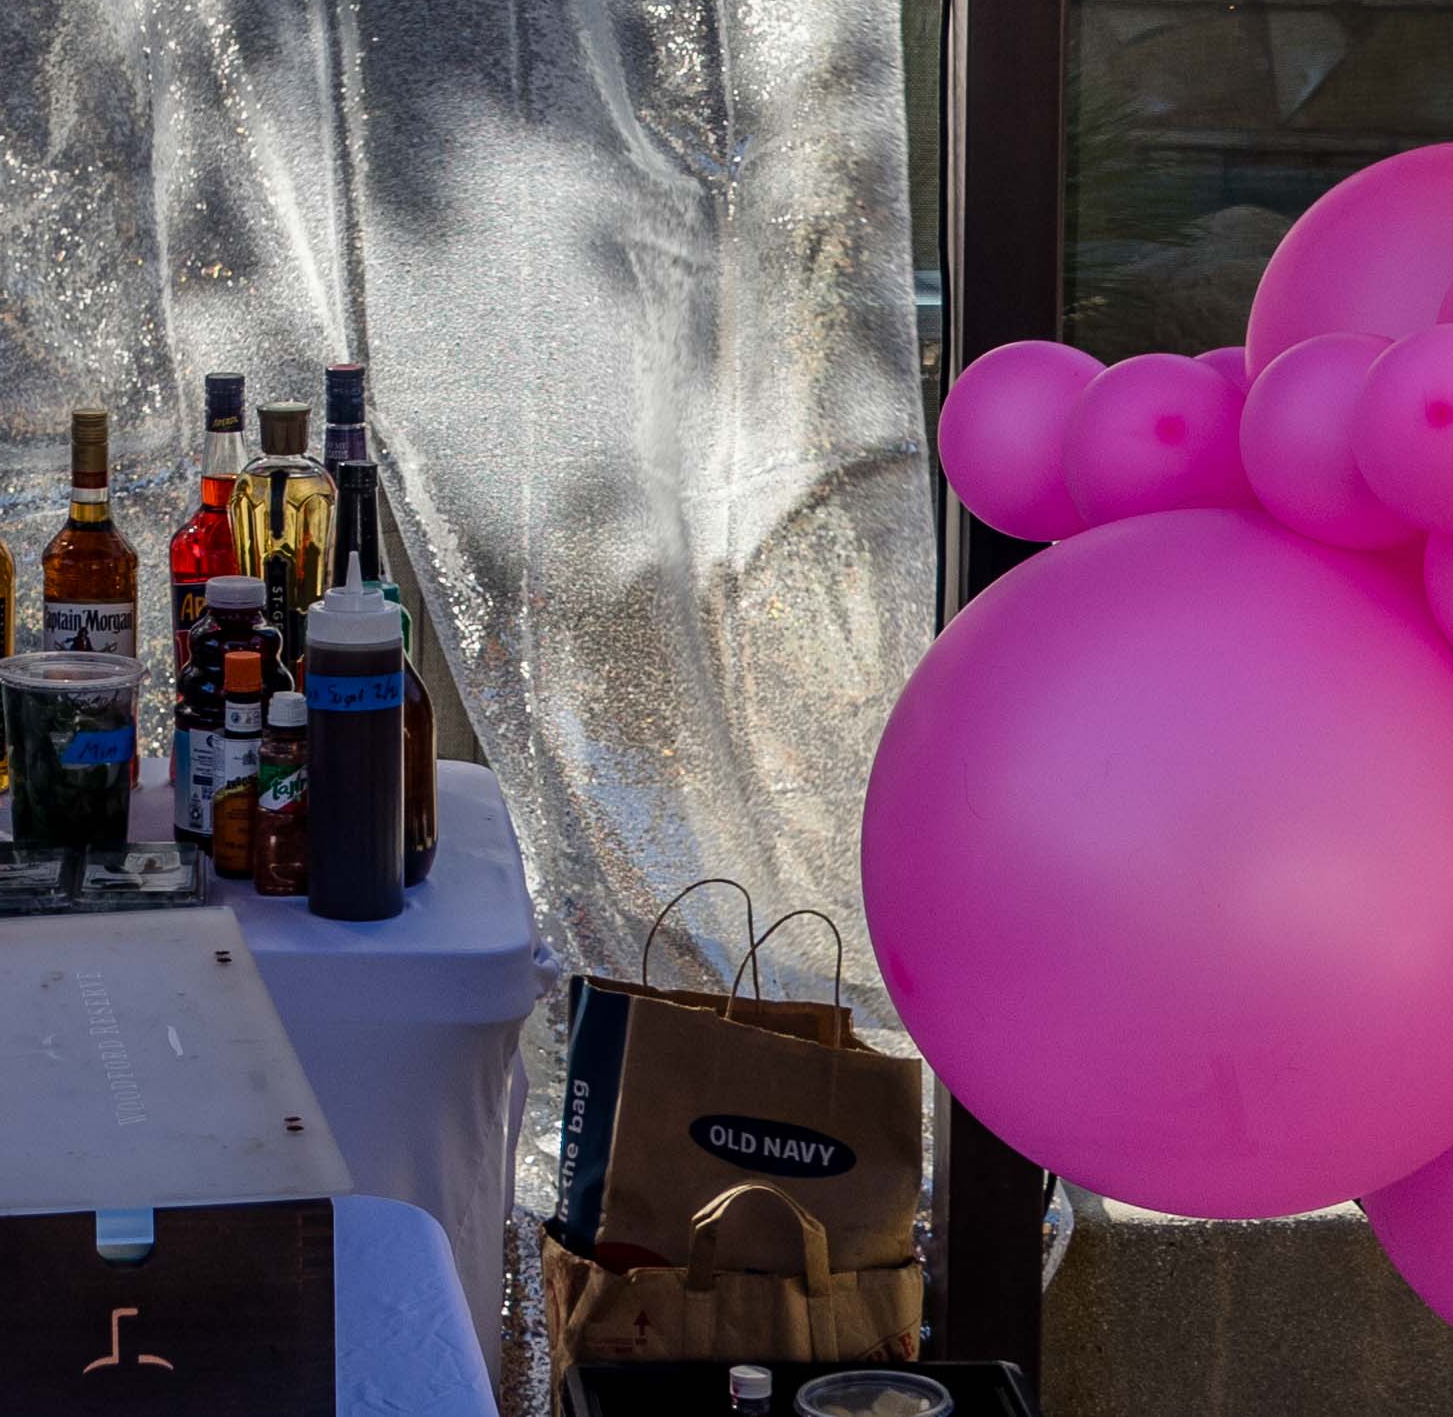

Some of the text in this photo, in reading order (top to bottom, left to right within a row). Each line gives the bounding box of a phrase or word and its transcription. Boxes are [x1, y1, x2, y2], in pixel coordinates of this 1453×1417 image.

[45, 605, 82, 634] aptain
[568, 1078, 590, 1134] bag
[561, 1142, 579, 1188] the
[709, 1124, 836, 1167] OLD NAVY
